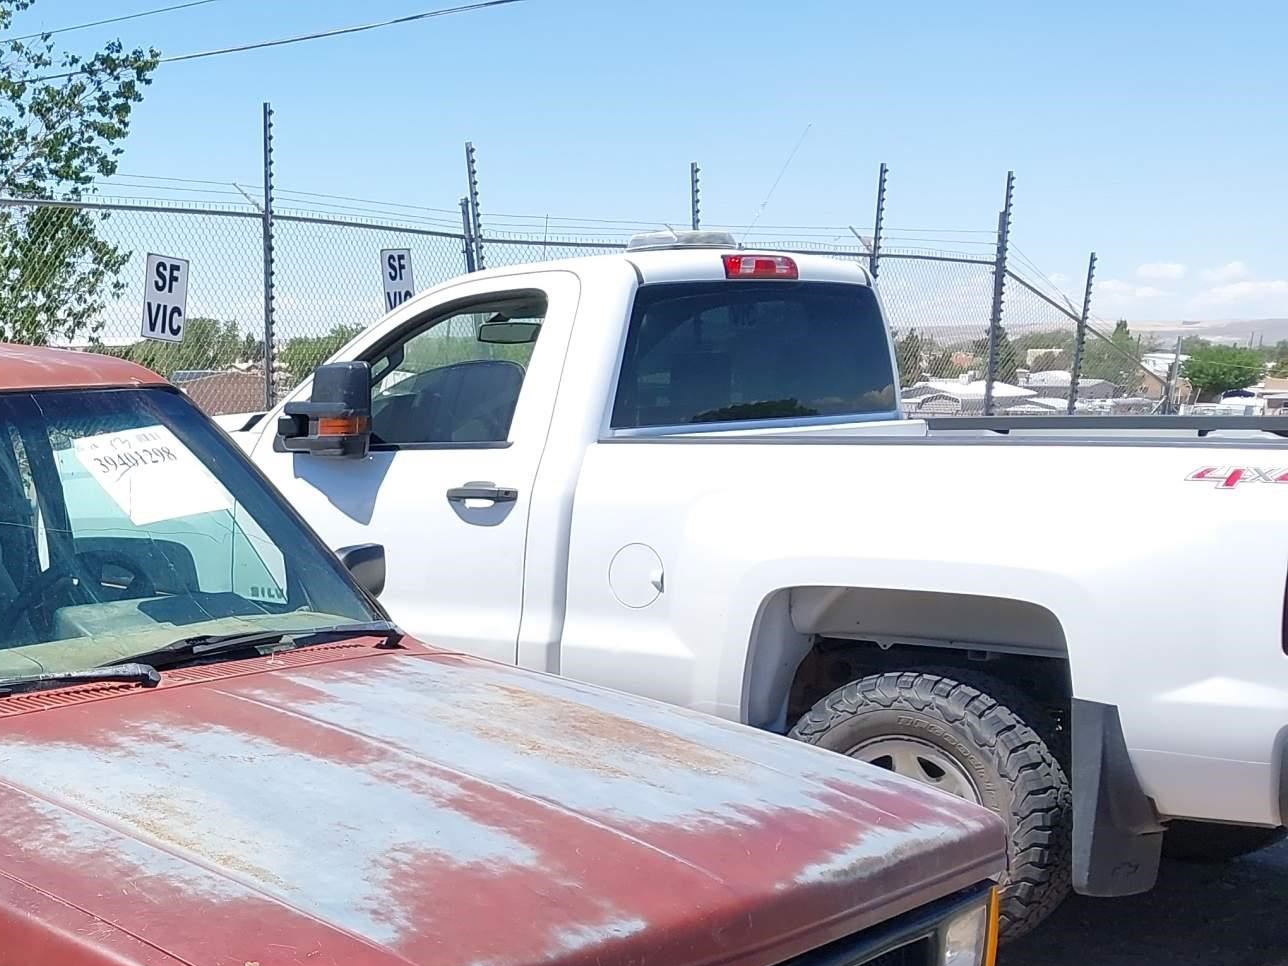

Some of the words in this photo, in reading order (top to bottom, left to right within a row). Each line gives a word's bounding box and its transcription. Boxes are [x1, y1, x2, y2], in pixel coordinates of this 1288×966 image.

[153, 261, 181, 293] SF
[387, 254, 406, 281] SF
[146, 301, 183, 337] VIC
[93, 446, 178, 474] 39401298
